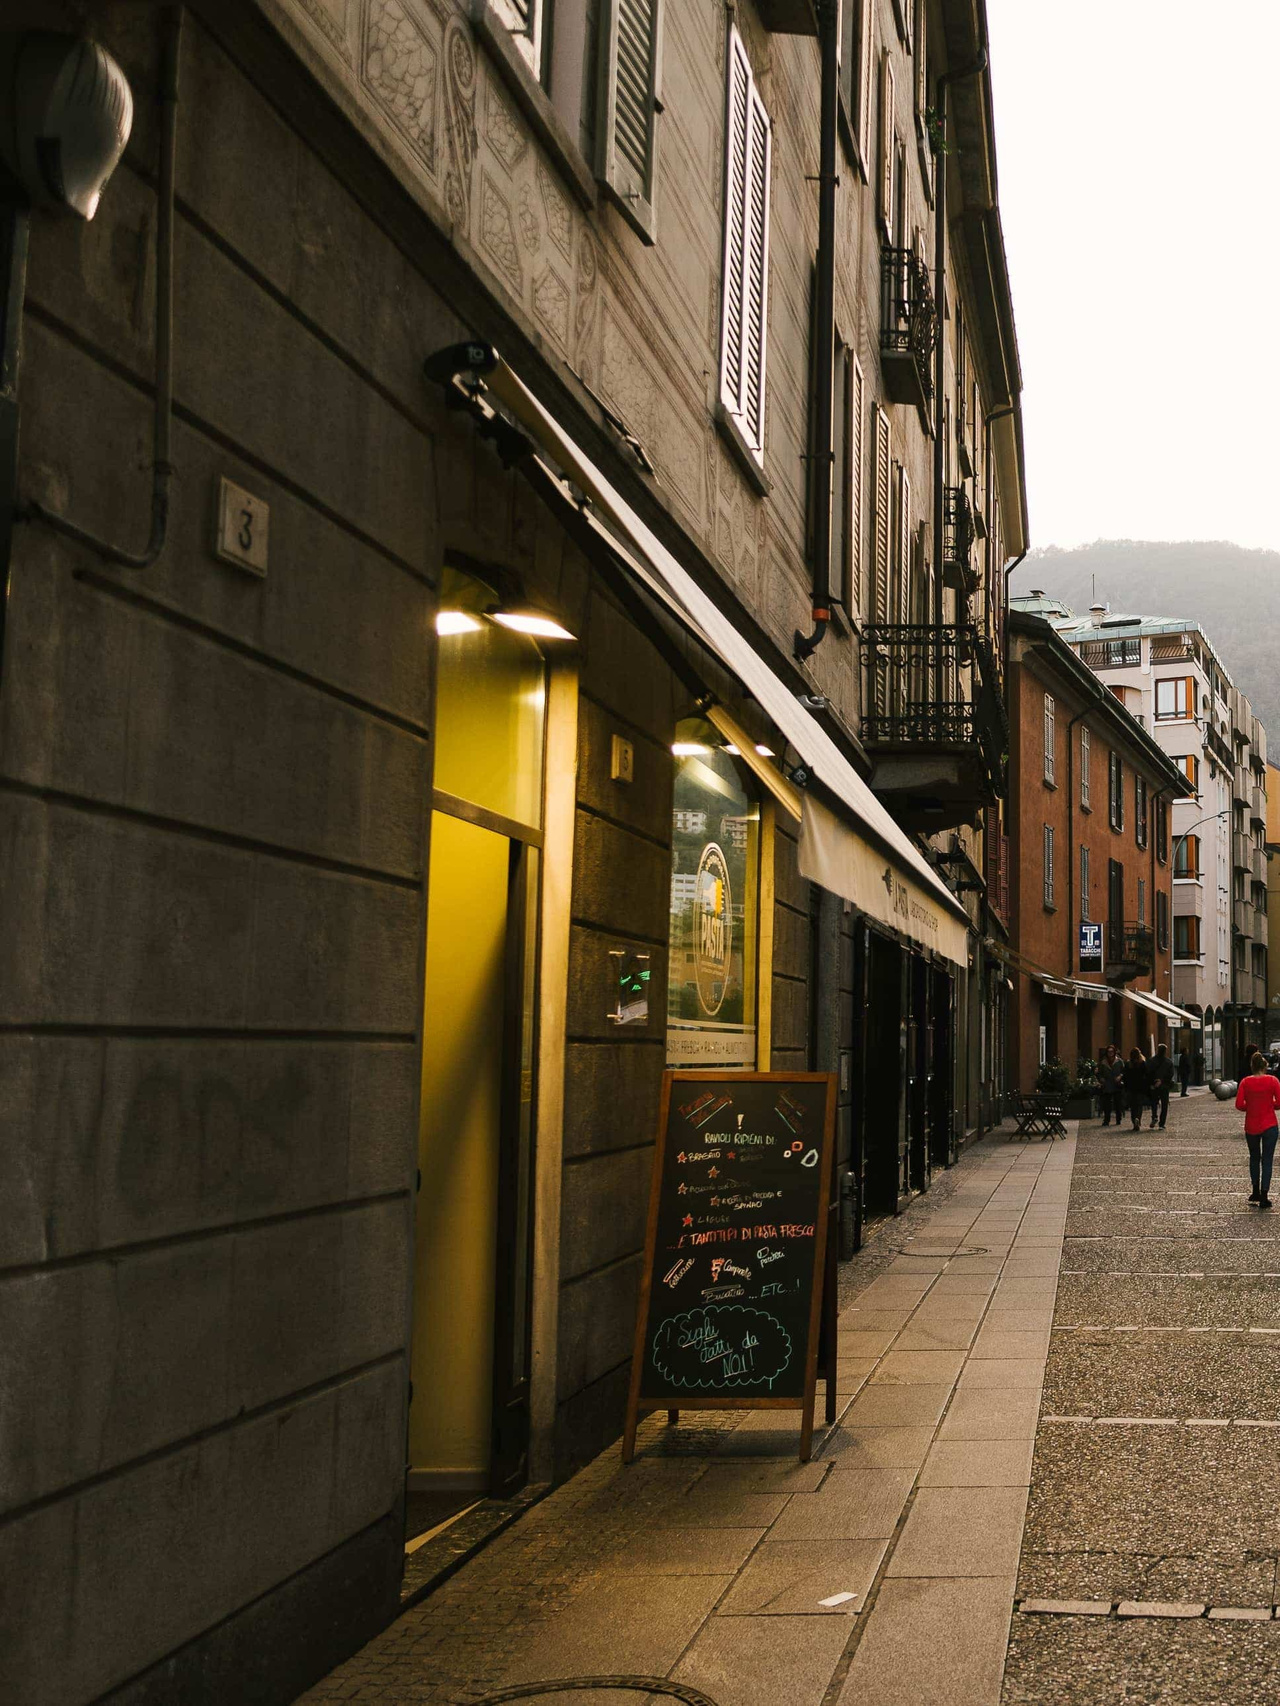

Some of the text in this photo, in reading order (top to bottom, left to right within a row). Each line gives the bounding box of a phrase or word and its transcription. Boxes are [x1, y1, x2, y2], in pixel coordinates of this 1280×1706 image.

[238, 509, 252, 551] 3
[701, 913, 724, 960] PASTA
[1082, 926, 1098, 945] T
[704, 1132, 732, 1144] RAVIOLI
[733, 1133, 763, 1145] RIPIENI
[733, 1200, 763, 1211] SPINACI
[741, 1227, 752, 1241] DI
[753, 1224, 778, 1240] PASTA
[677, 1316, 720, 1350] Sughi
[741, 1329, 760, 1349] da
